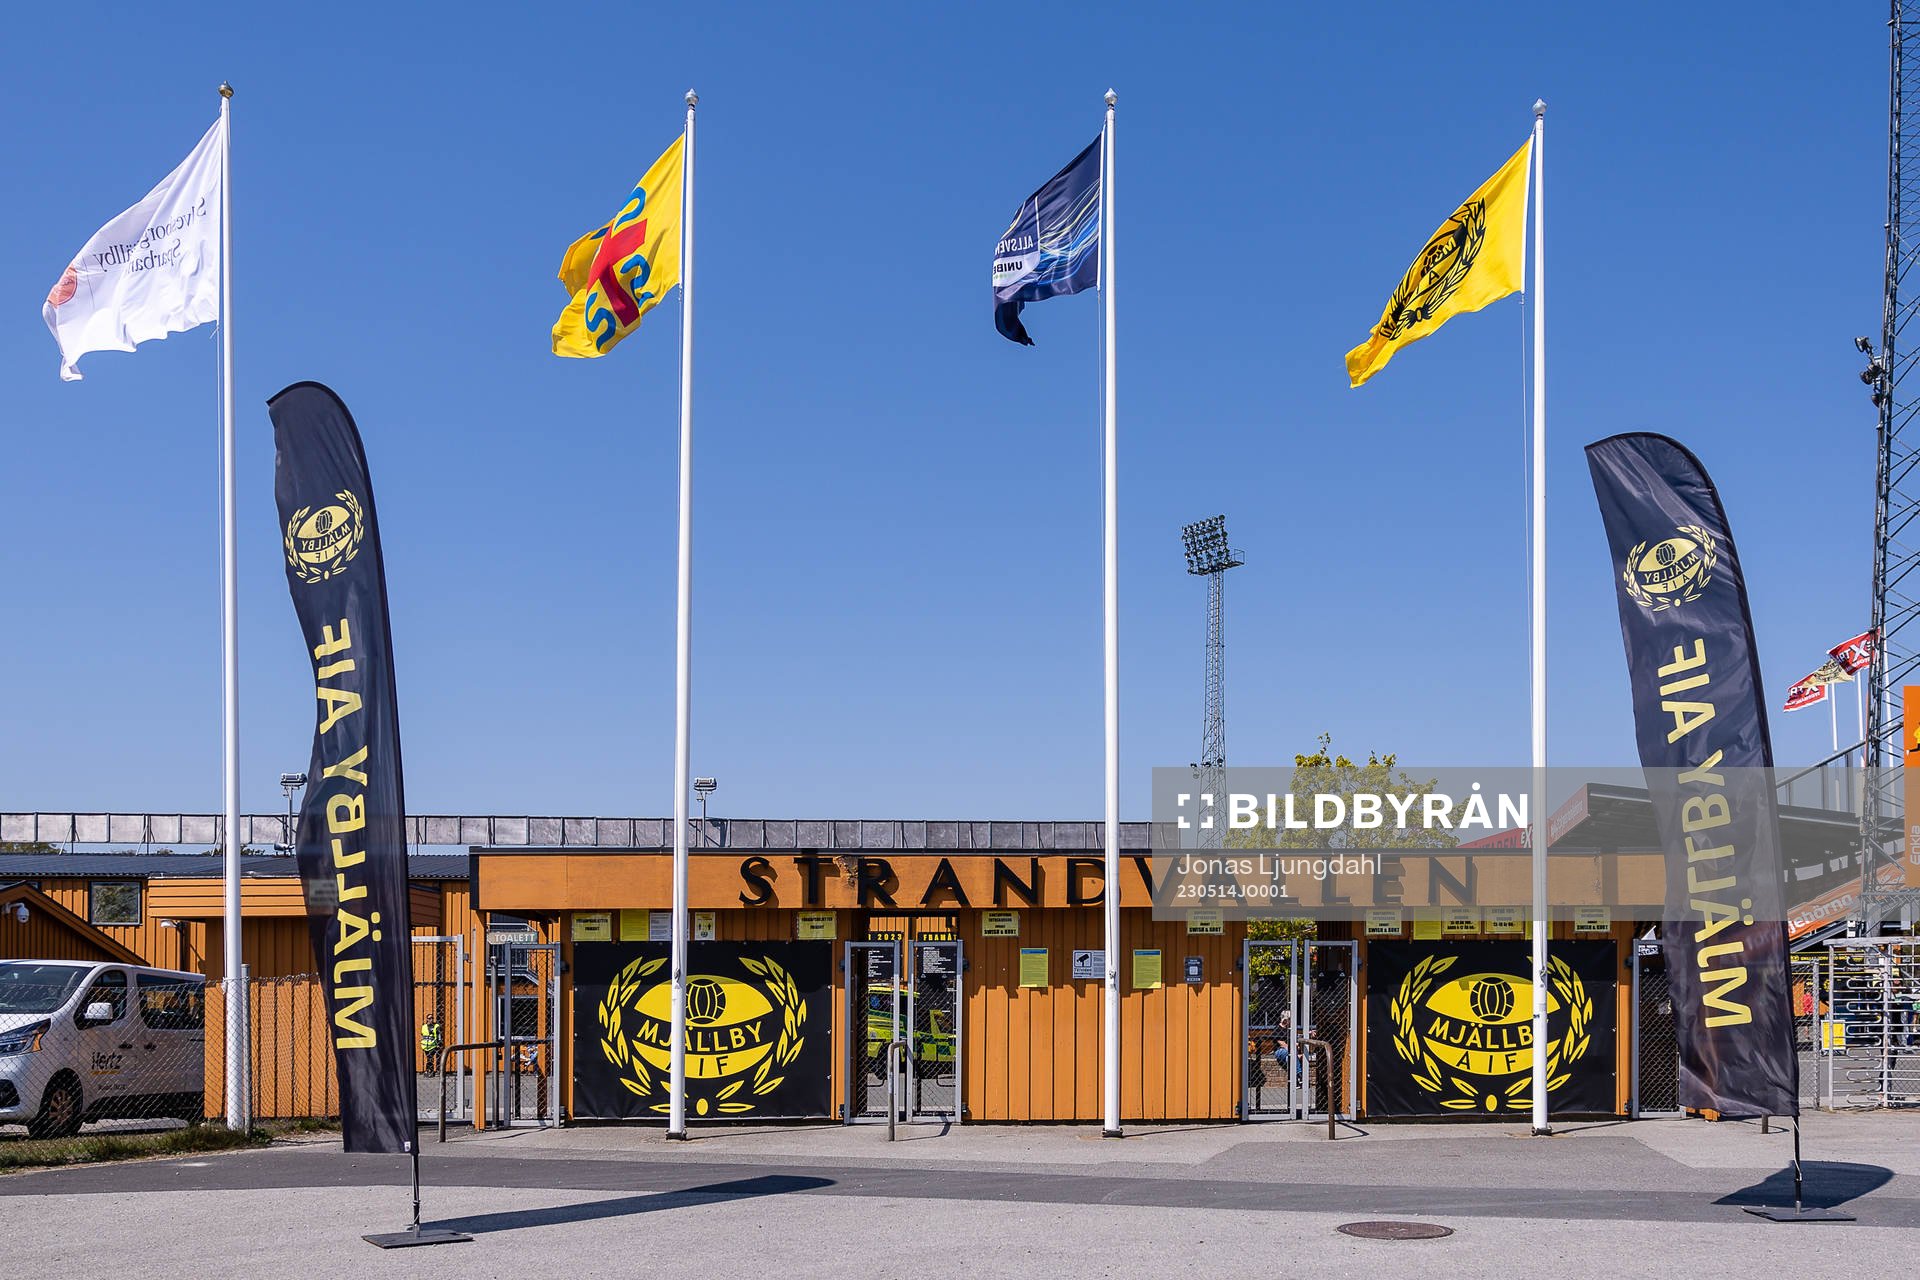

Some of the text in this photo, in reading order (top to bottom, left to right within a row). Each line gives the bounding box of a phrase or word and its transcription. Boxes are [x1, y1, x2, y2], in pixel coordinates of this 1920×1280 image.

[739, 856, 1479, 905] STRANDVALLEN
[494, 933, 536, 942] TOALETT
[877, 933, 903, 941] 2023
[1427, 1016, 1534, 1050] MJÄLLB
[1455, 1052, 1518, 1074] AIF
